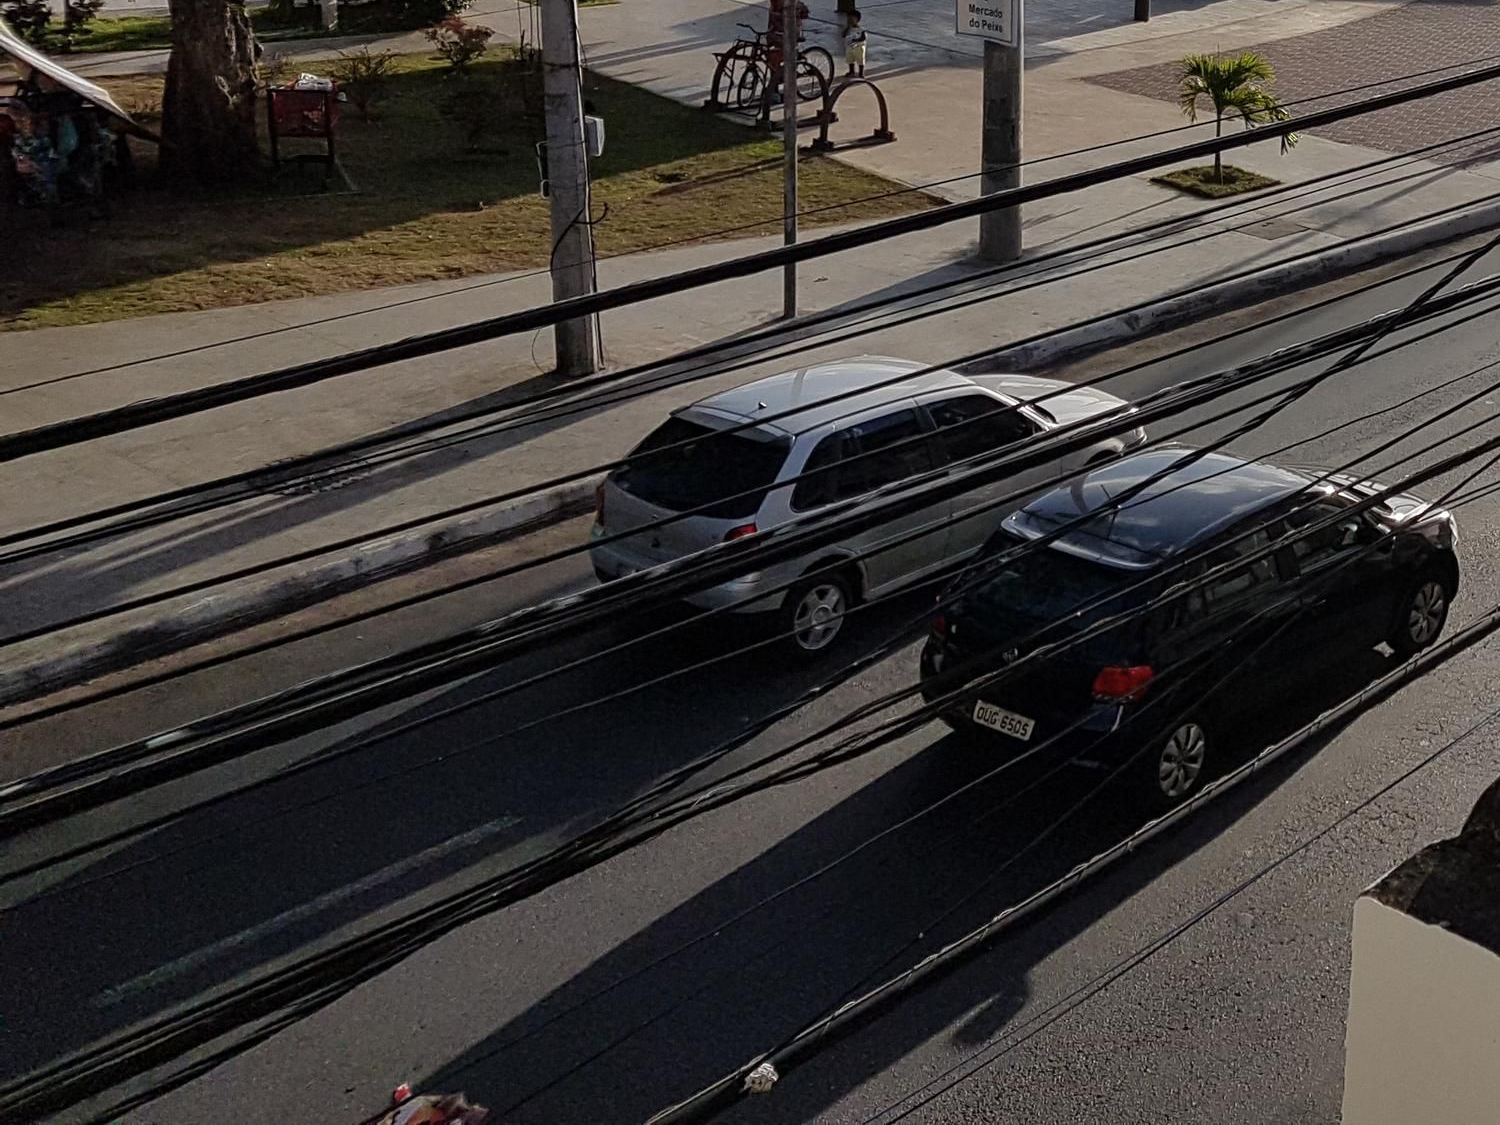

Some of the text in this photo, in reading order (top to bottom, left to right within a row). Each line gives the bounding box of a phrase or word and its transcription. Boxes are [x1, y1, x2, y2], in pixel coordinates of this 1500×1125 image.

[968, 3, 1003, 19] Mercado
[969, 17, 980, 28] do
[977, 707, 1028, 736] OUG 6505
